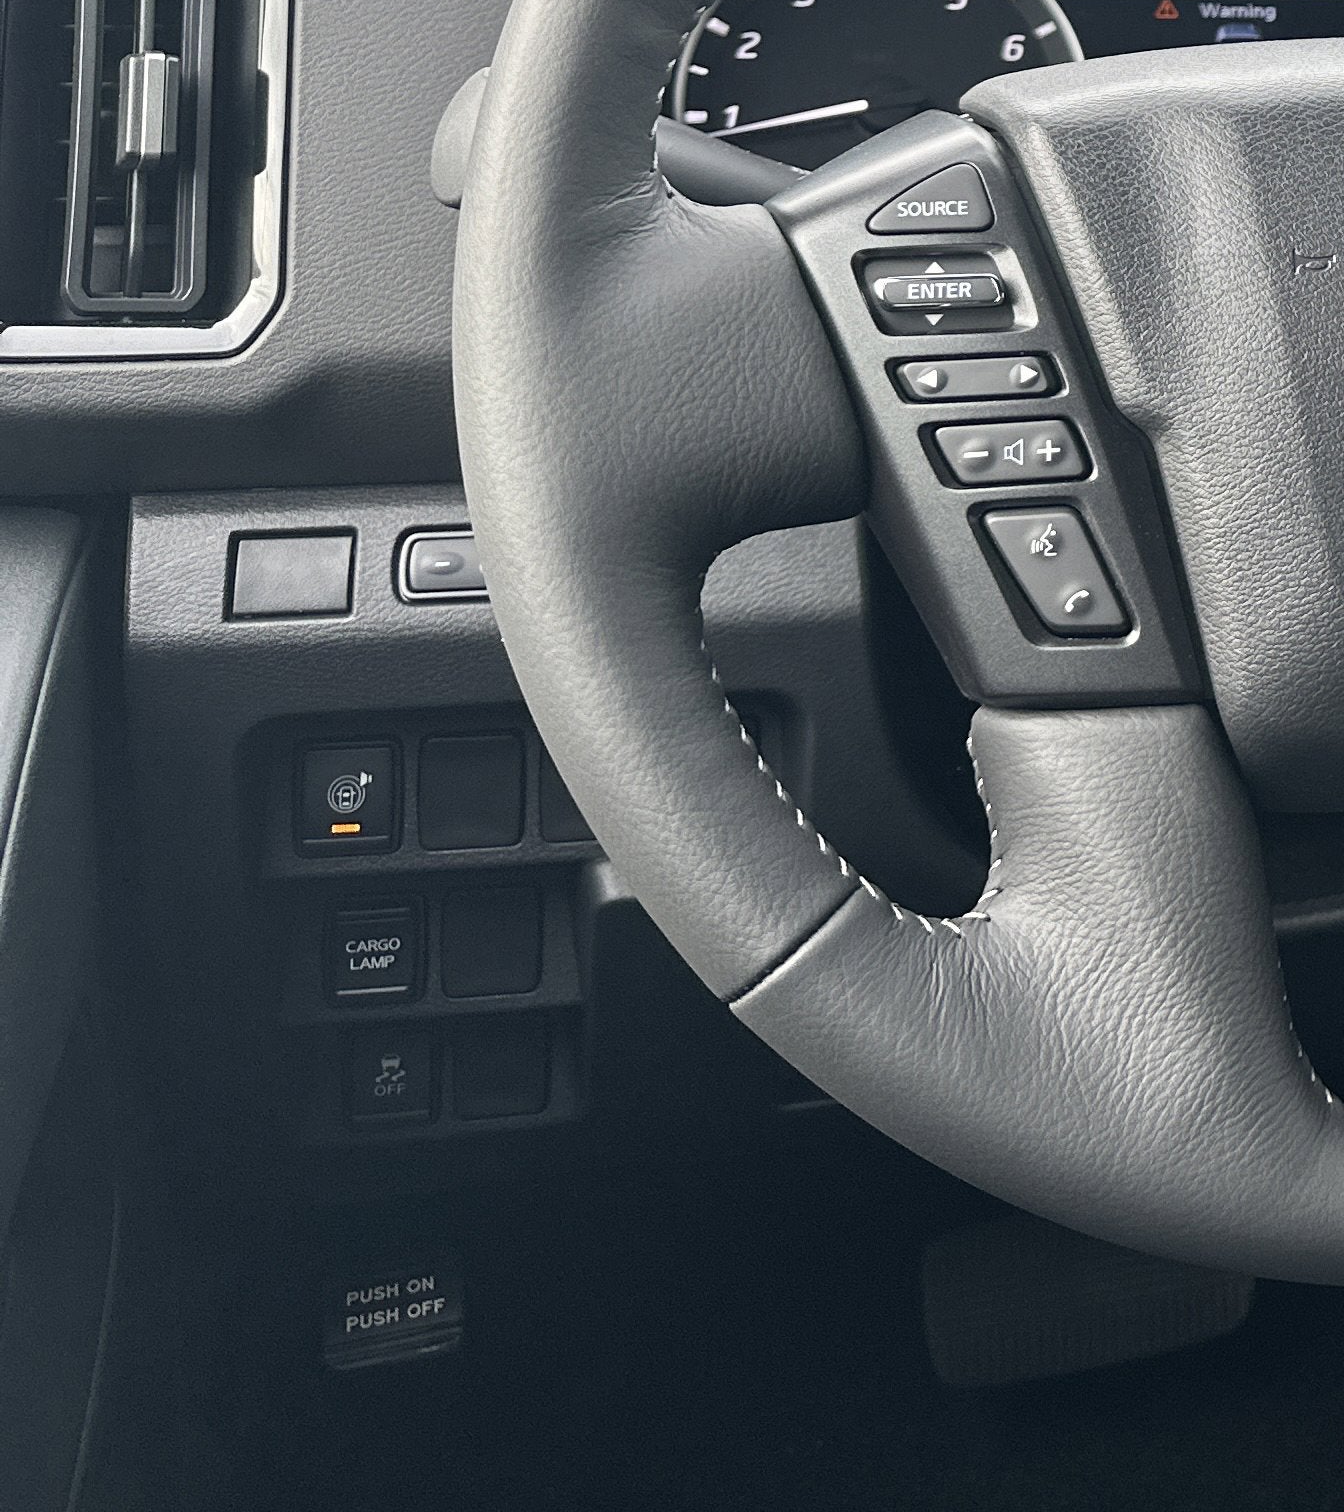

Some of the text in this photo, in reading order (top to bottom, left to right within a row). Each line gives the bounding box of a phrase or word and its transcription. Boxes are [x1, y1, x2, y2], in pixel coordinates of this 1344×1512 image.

[1197, 2, 1277, 23] Warning
[734, 31, 762, 60] 2
[1001, 34, 1026, 62] 6
[722, 105, 739, 129] 1
[897, 199, 969, 218] SOURCE
[907, 282, 972, 300] ENTER
[345, 937, 401, 953] CARGO
[350, 955, 395, 970] LAMP
[374, 1083, 406, 1097] OFF
[346, 1275, 435, 1306] PUSH ON
[346, 1297, 446, 1332] PUSH OFF
